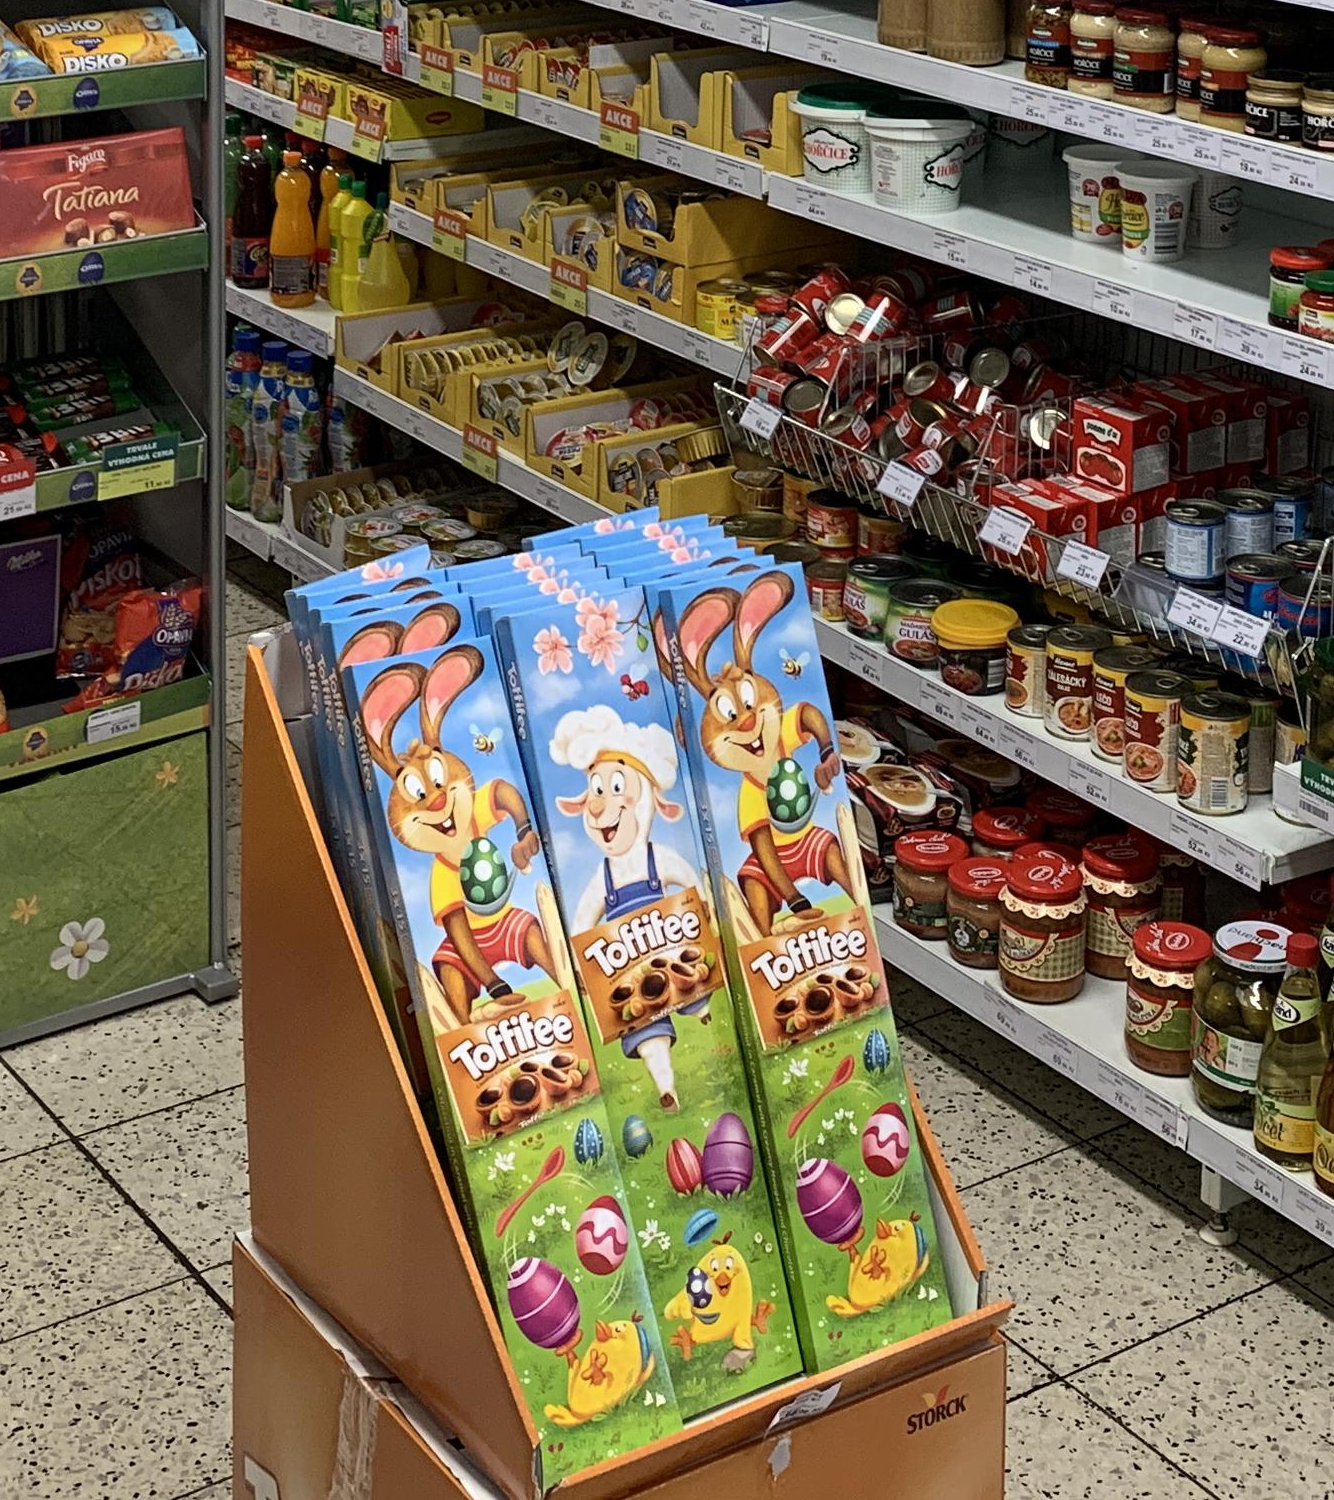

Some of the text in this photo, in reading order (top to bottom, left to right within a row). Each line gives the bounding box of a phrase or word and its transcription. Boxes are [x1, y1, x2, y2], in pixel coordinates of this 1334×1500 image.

[38, 19, 104, 38] DISKO
[63, 52, 130, 73] DISKO
[425, 51, 449, 69] AKCE
[487, 71, 512, 90] AKCE
[301, 98, 324, 116] AKCE
[606, 108, 633, 129] AKCE
[67, 147, 107, 173] Figaro
[42, 182, 140, 221] Tatiana
[126, 441, 158, 454] TRVALE
[583, 905, 701, 978] Toffifee
[751, 927, 867, 991] Toffifee
[449, 1011, 575, 1081] Toffifee
[906, 1395, 969, 1436] STORCK
